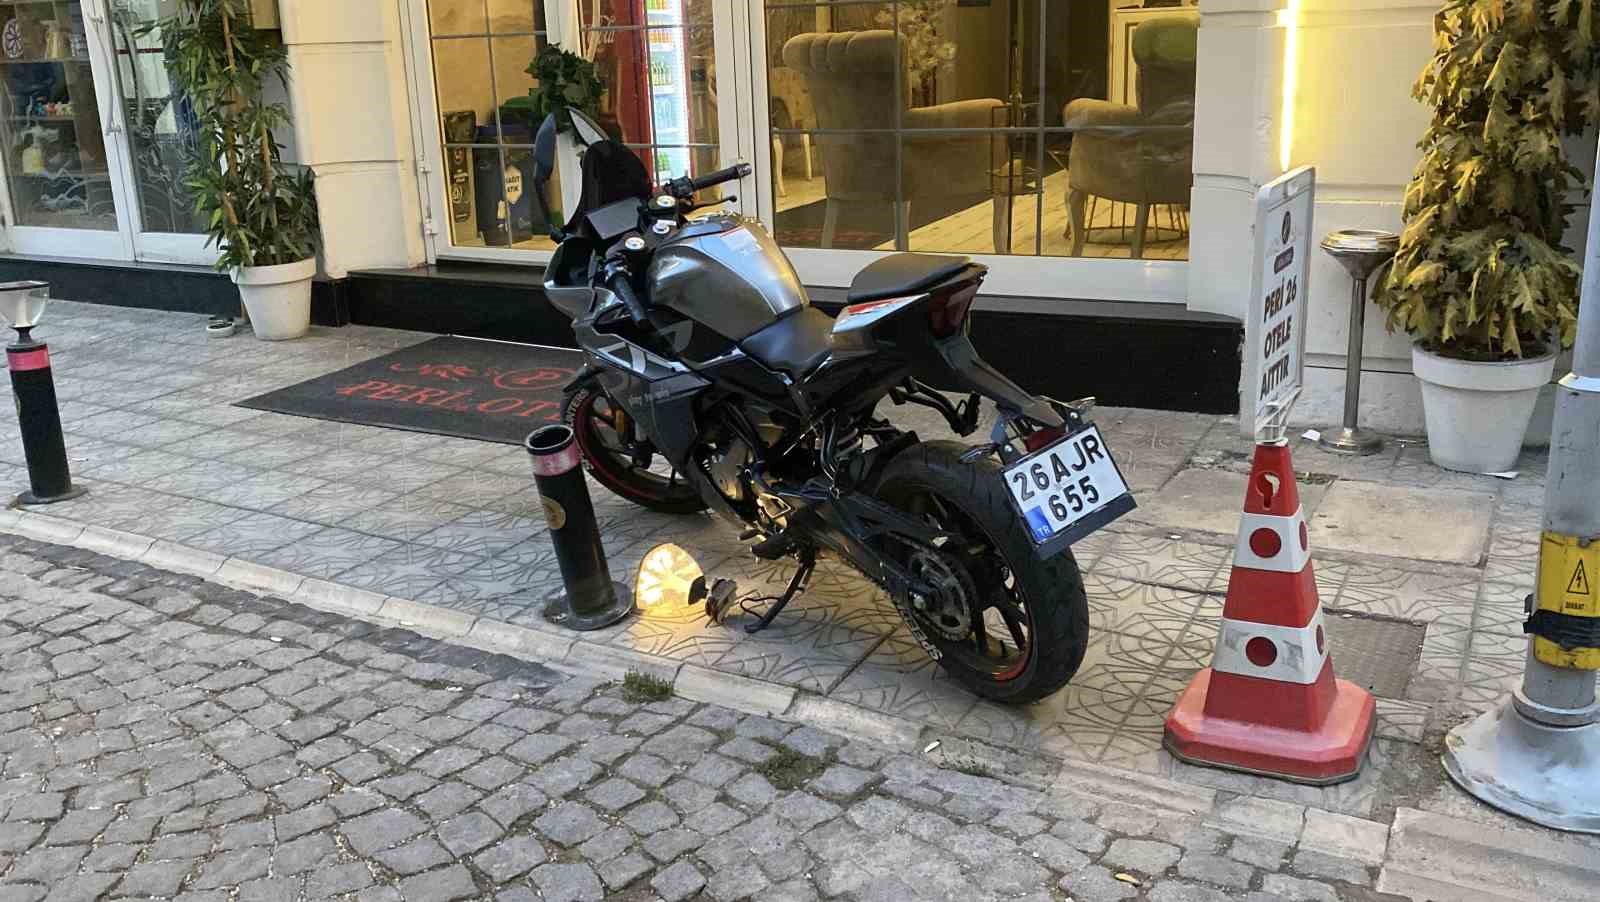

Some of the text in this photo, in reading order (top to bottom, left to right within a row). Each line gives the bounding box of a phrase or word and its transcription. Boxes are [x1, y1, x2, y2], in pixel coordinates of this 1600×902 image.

[1285, 275, 1298, 306] 26
[1264, 314, 1292, 359] OTELE
[1013, 463, 1050, 502] 26
[1048, 475, 1099, 521] 655
[1037, 525, 1051, 537] TR
